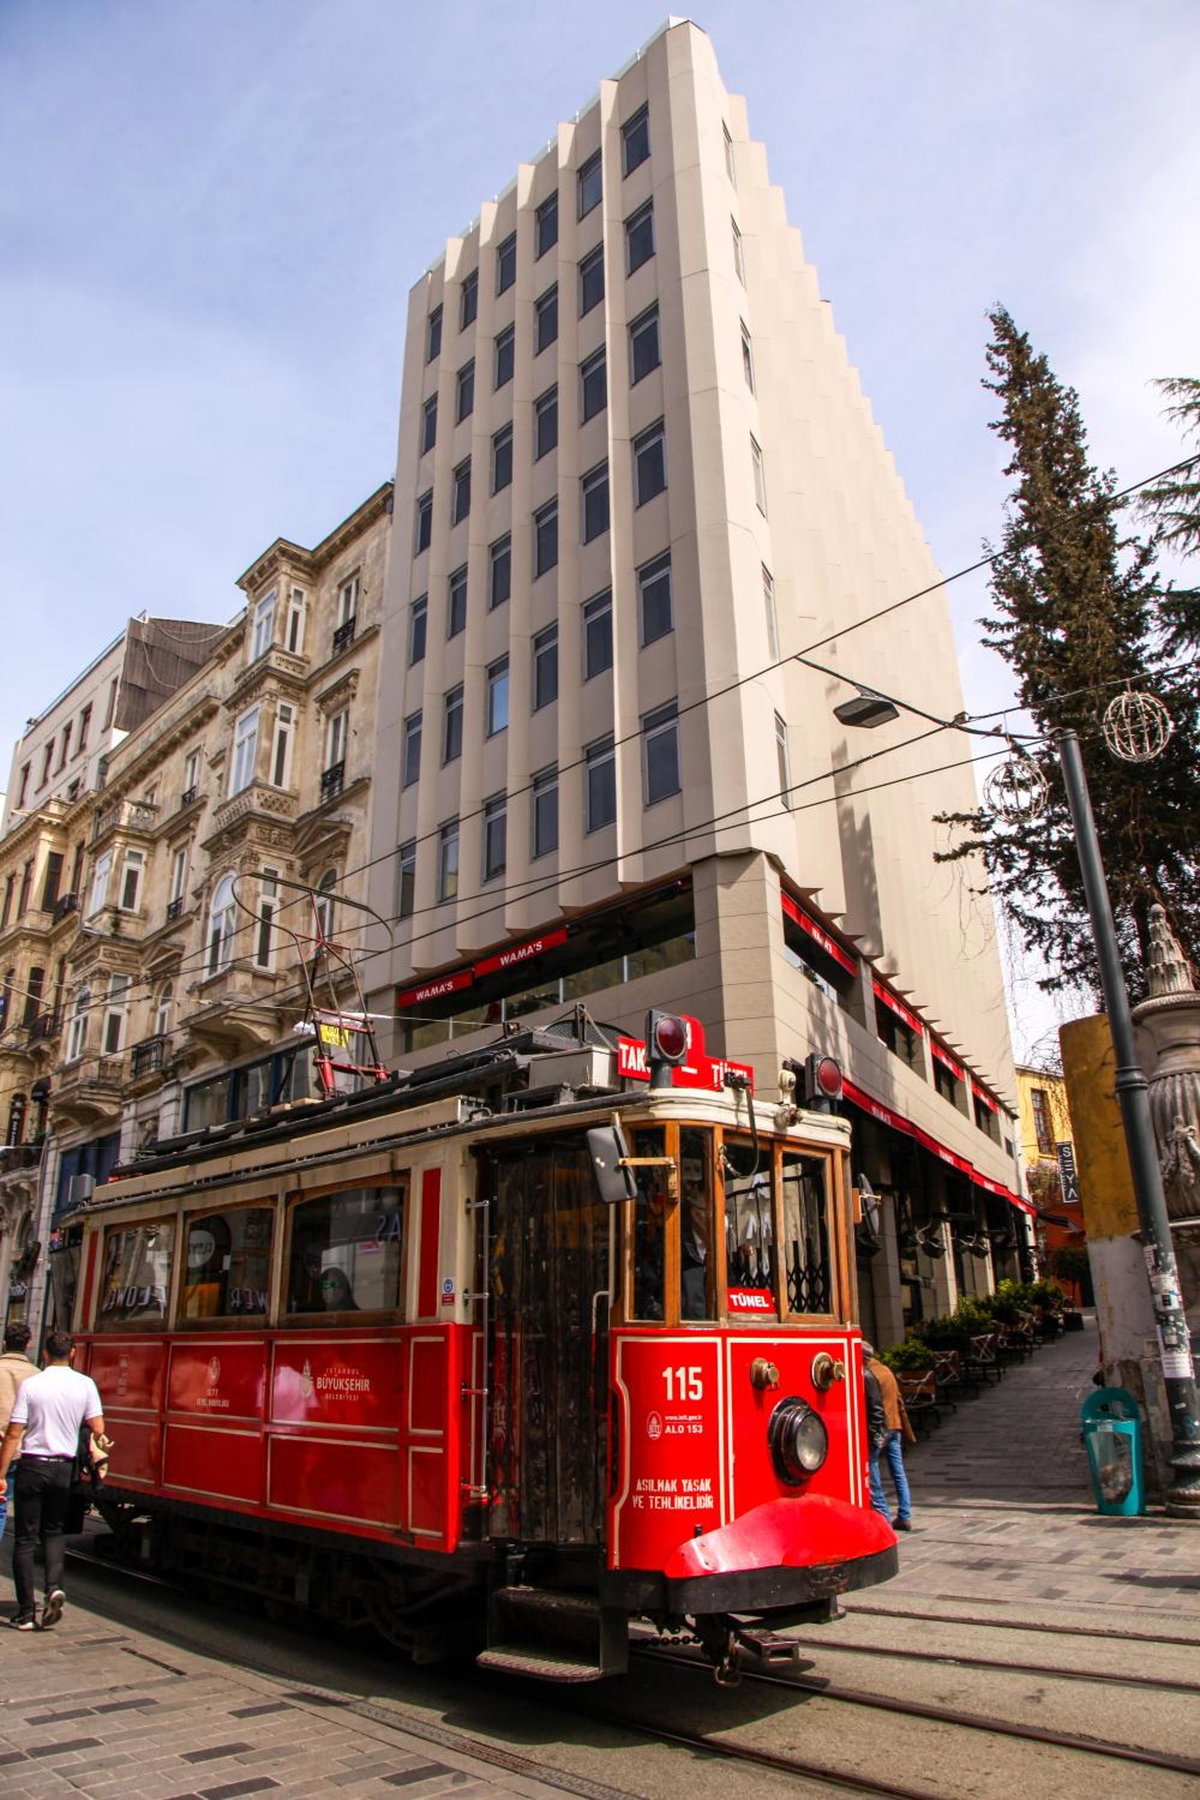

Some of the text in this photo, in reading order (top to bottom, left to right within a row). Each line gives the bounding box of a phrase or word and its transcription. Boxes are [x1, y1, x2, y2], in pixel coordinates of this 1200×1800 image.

[500, 940, 543, 967] WAMA'S
[415, 981, 454, 1001] WAMA'S
[619, 1043, 651, 1074] TAK
[729, 1292, 769, 1308] TÜNEL
[661, 1366, 704, 1401] 115
[665, 1424, 684, 1434] ALO
[686, 1424, 704, 1434] 153
[681, 1478, 712, 1493] YASAK
[632, 1495, 644, 1509] VE
